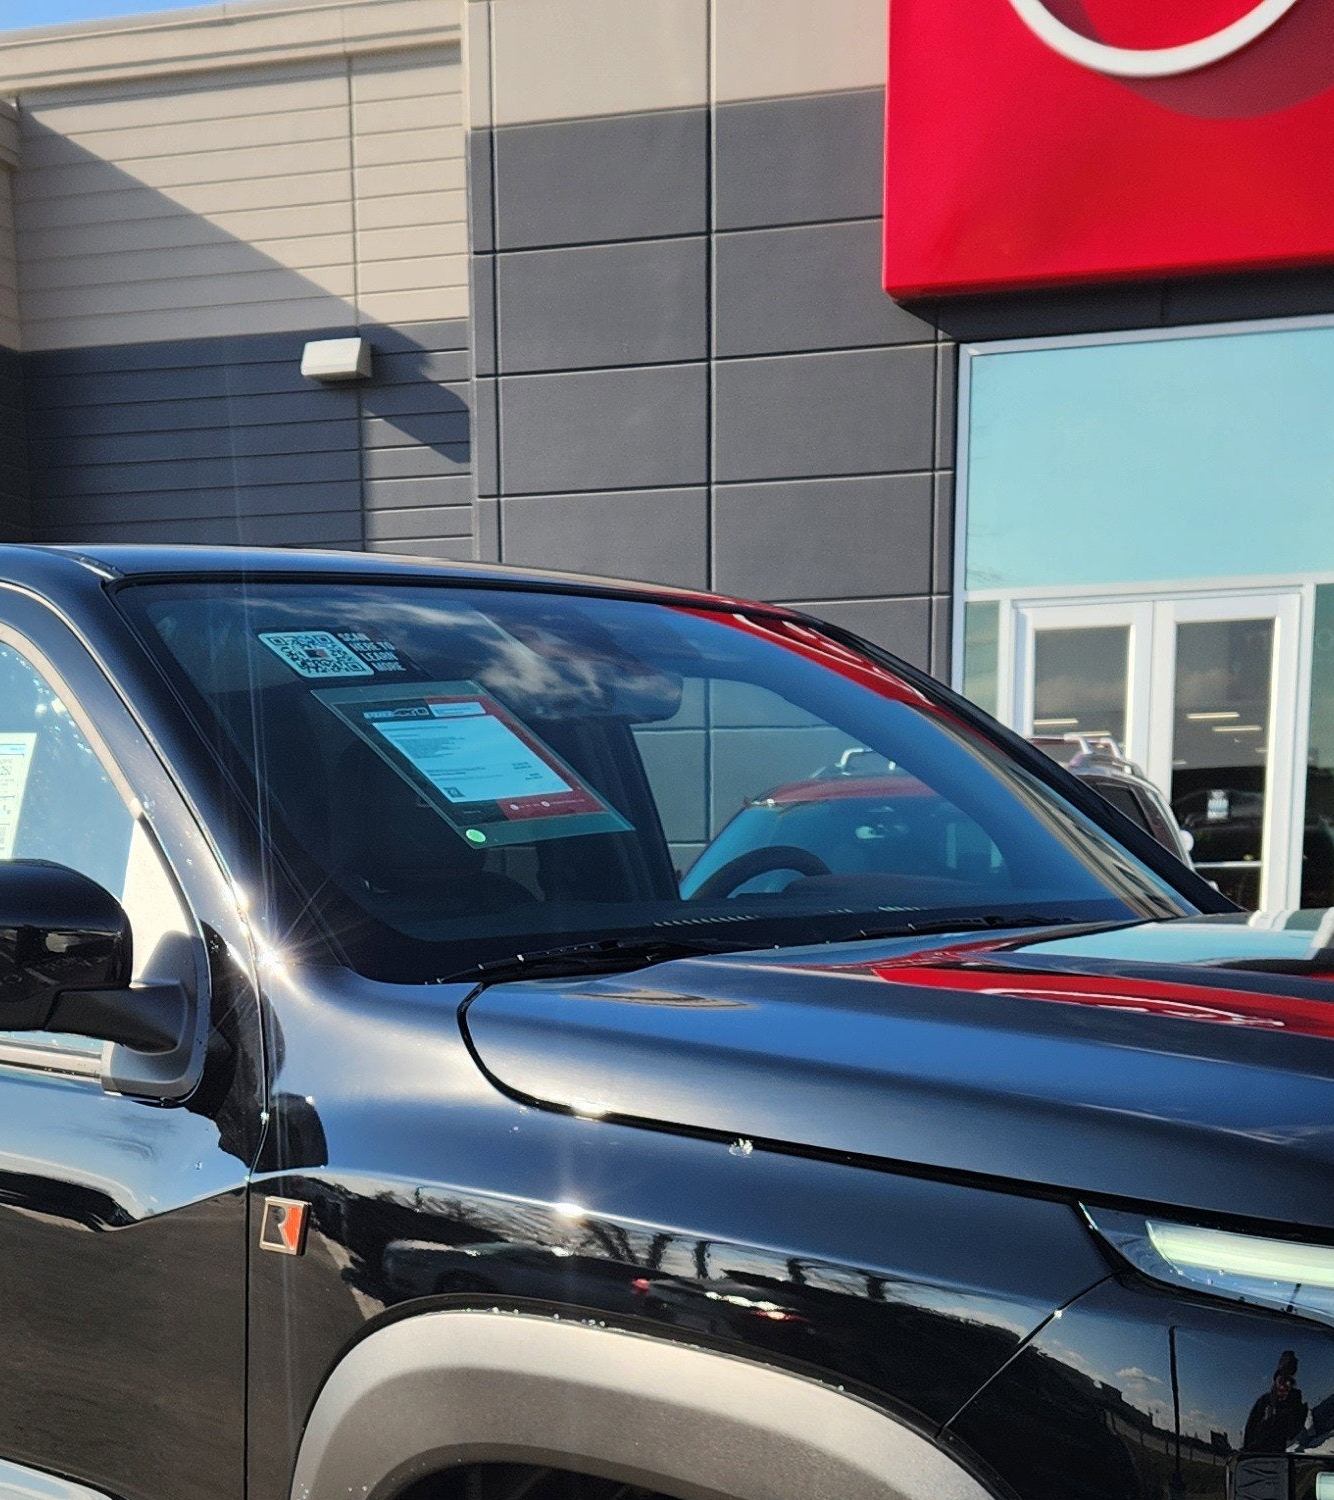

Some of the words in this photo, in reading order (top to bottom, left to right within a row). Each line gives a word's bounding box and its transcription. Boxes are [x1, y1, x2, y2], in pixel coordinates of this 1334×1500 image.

[337, 632, 371, 642] SCAN
[359, 651, 399, 662] LEARN
[370, 661, 407, 672] MORE
